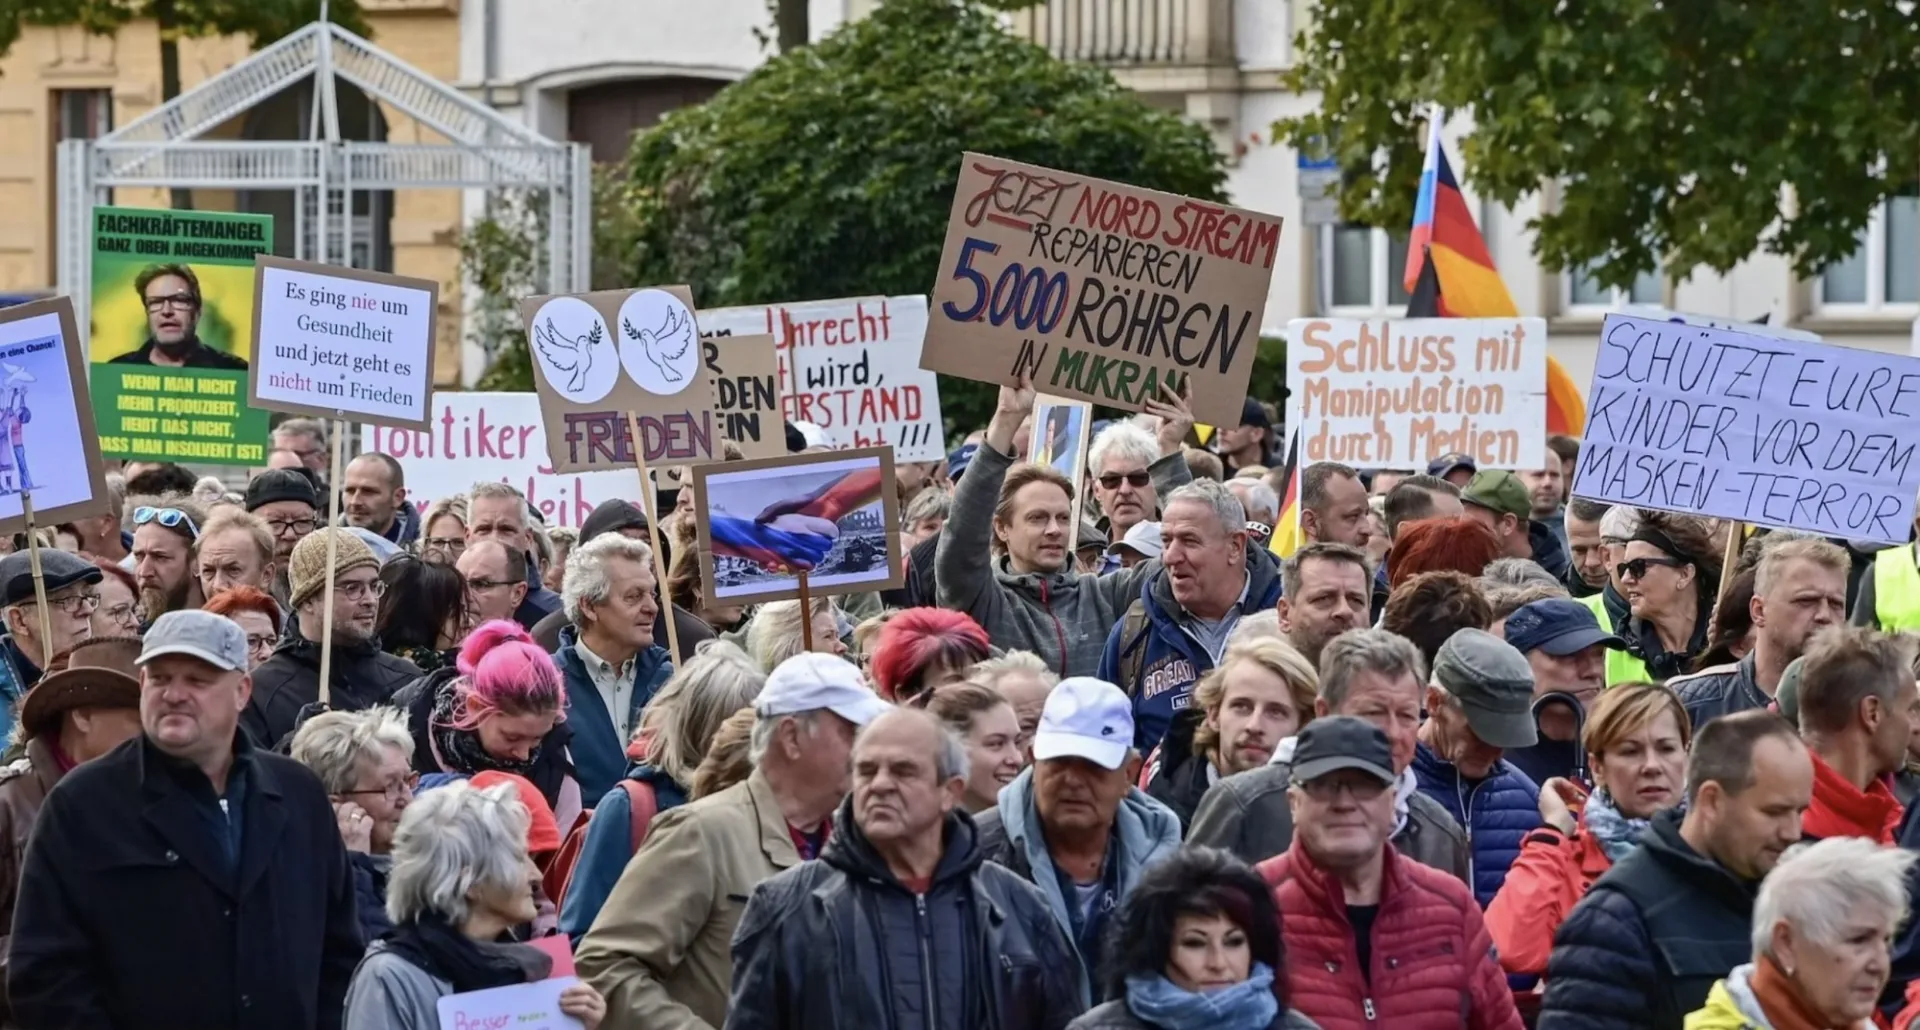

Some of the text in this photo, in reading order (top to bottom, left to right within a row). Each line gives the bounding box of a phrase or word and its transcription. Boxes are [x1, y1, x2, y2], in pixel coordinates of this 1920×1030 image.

[97, 214, 266, 242] FACHKRÄFTEMANGEL
[965, 163, 1280, 268] JETZT NORD STREAM
[97, 236, 132, 253] GANZ
[136, 239, 169, 256] OBEN
[1028, 223, 1203, 294] REPARIEREN
[286, 281, 408, 316] Es ging nie um
[297, 314, 394, 344] Gesundheit
[767, 301, 891, 350] Unrecht
[1065, 278, 1251, 375] RÖHREN
[275, 343, 411, 376] und jetzt geht es
[1011, 339, 1048, 381] IN
[1299, 321, 1526, 373] Schluss mit
[121, 374, 237, 395] WENN MAN NICHT
[269, 371, 413, 406] nicht um Frieden
[807, 348, 883, 389] wird,
[1598, 322, 1920, 418] SCHÜTZT EURE
[117, 395, 240, 418] MEHR PRODUZIERT,
[1304, 376, 1504, 434] Manipulation
[132, 438, 162, 455] MAN
[165, 440, 235, 459] INSOLVENT
[236, 444, 264, 461] IST!
[161, 419, 190, 436] DAS
[192, 421, 236, 439] NICHT,
[564, 410, 713, 464] FRIEDEN
[1307, 415, 1520, 465] durch Medien
[1752, 413, 1820, 470] VOR
[1823, 429, 1916, 486] DEM
